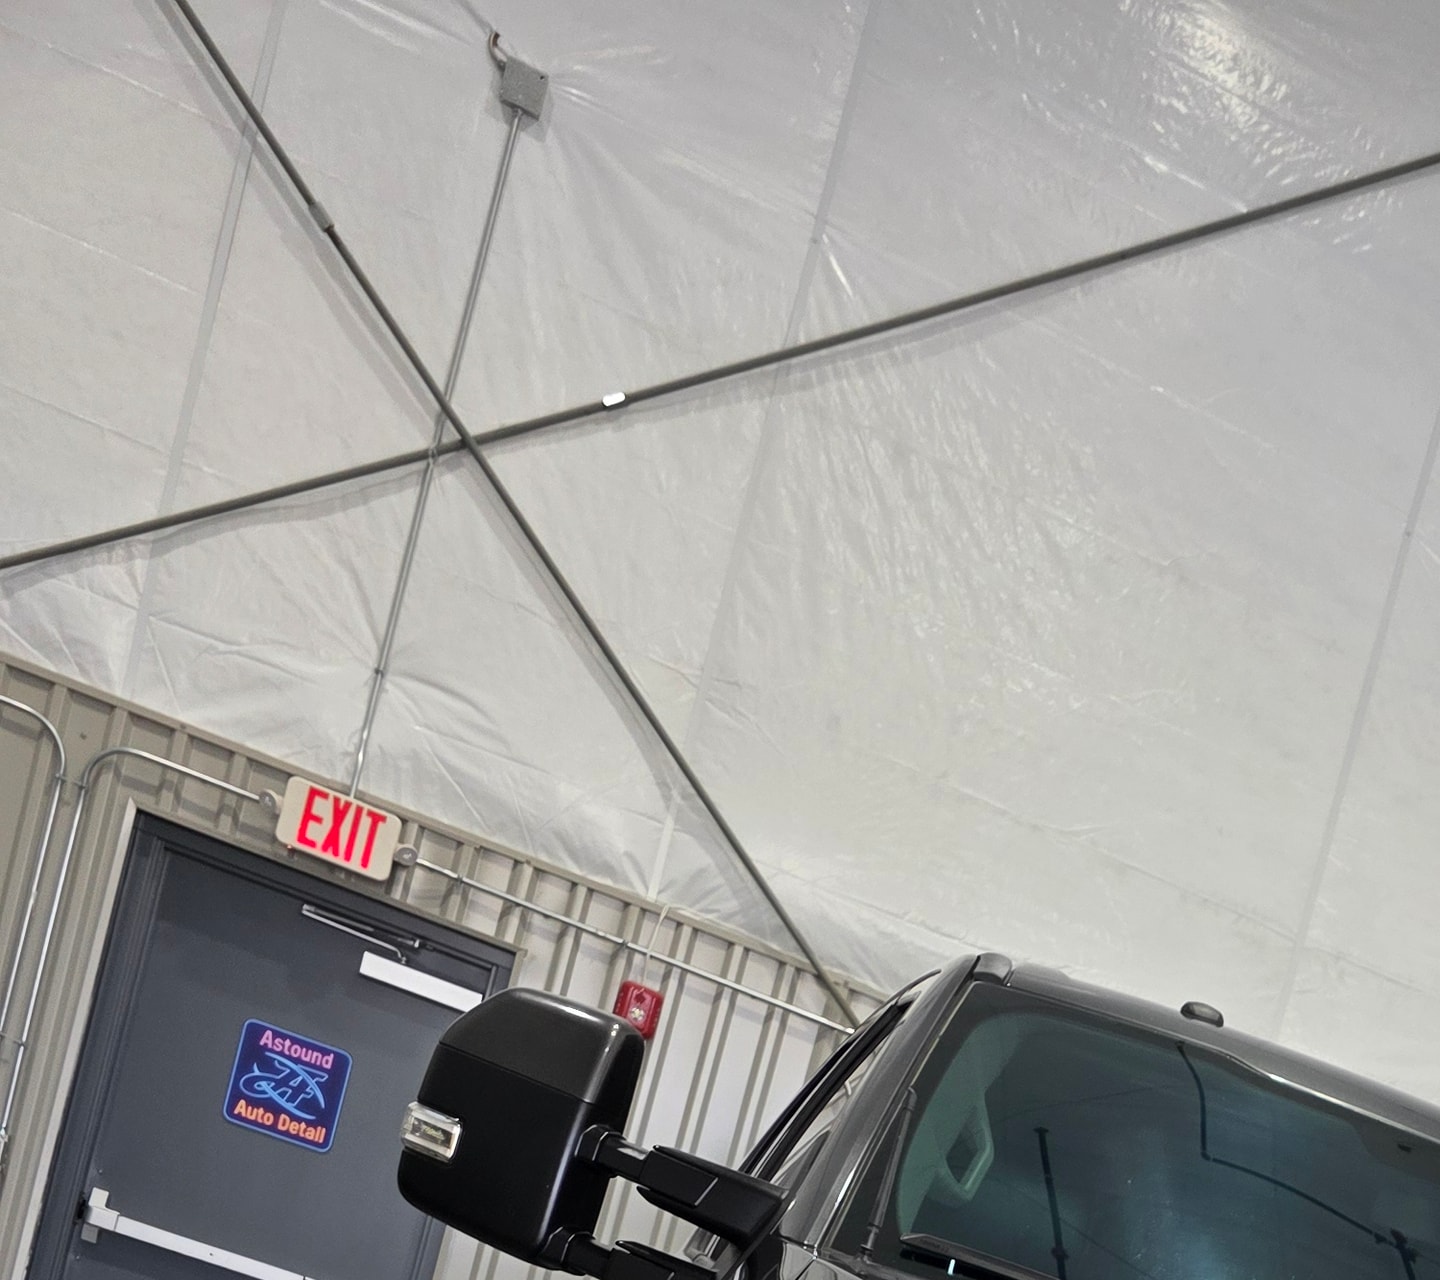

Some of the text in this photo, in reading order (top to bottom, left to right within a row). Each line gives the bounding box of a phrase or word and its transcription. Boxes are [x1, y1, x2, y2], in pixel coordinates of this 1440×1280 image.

[297, 786, 387, 868] EXIT
[260, 1030, 334, 1069] Astound
[234, 1099, 326, 1143] Auto Detail
